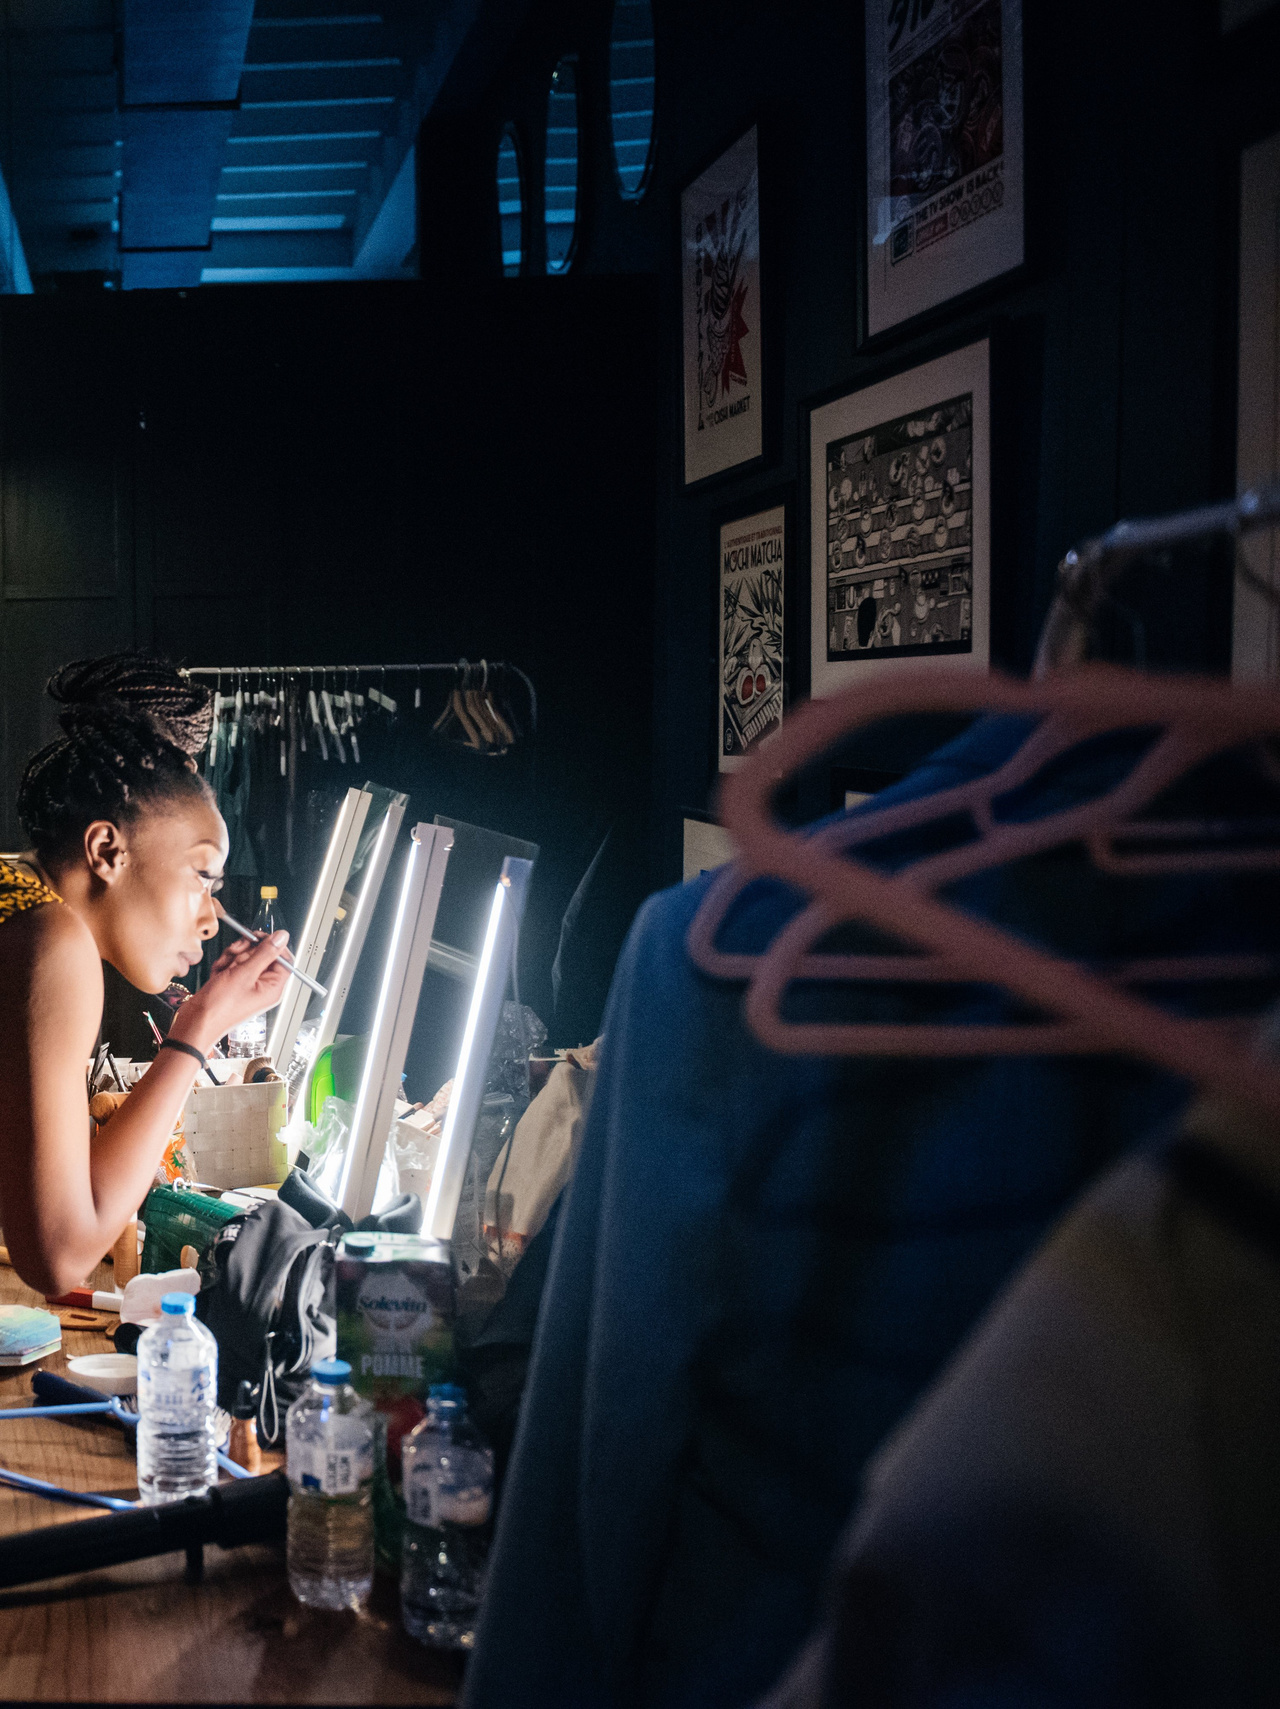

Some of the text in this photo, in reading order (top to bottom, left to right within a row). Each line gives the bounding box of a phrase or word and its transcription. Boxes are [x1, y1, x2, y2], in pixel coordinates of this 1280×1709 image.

[939, 185, 963, 211] SHOW
[966, 179, 974, 193] IS
[730, 395, 751, 418] MARKET
[751, 538, 782, 568] MATCHA
[360, 1354, 424, 1378] POMME
